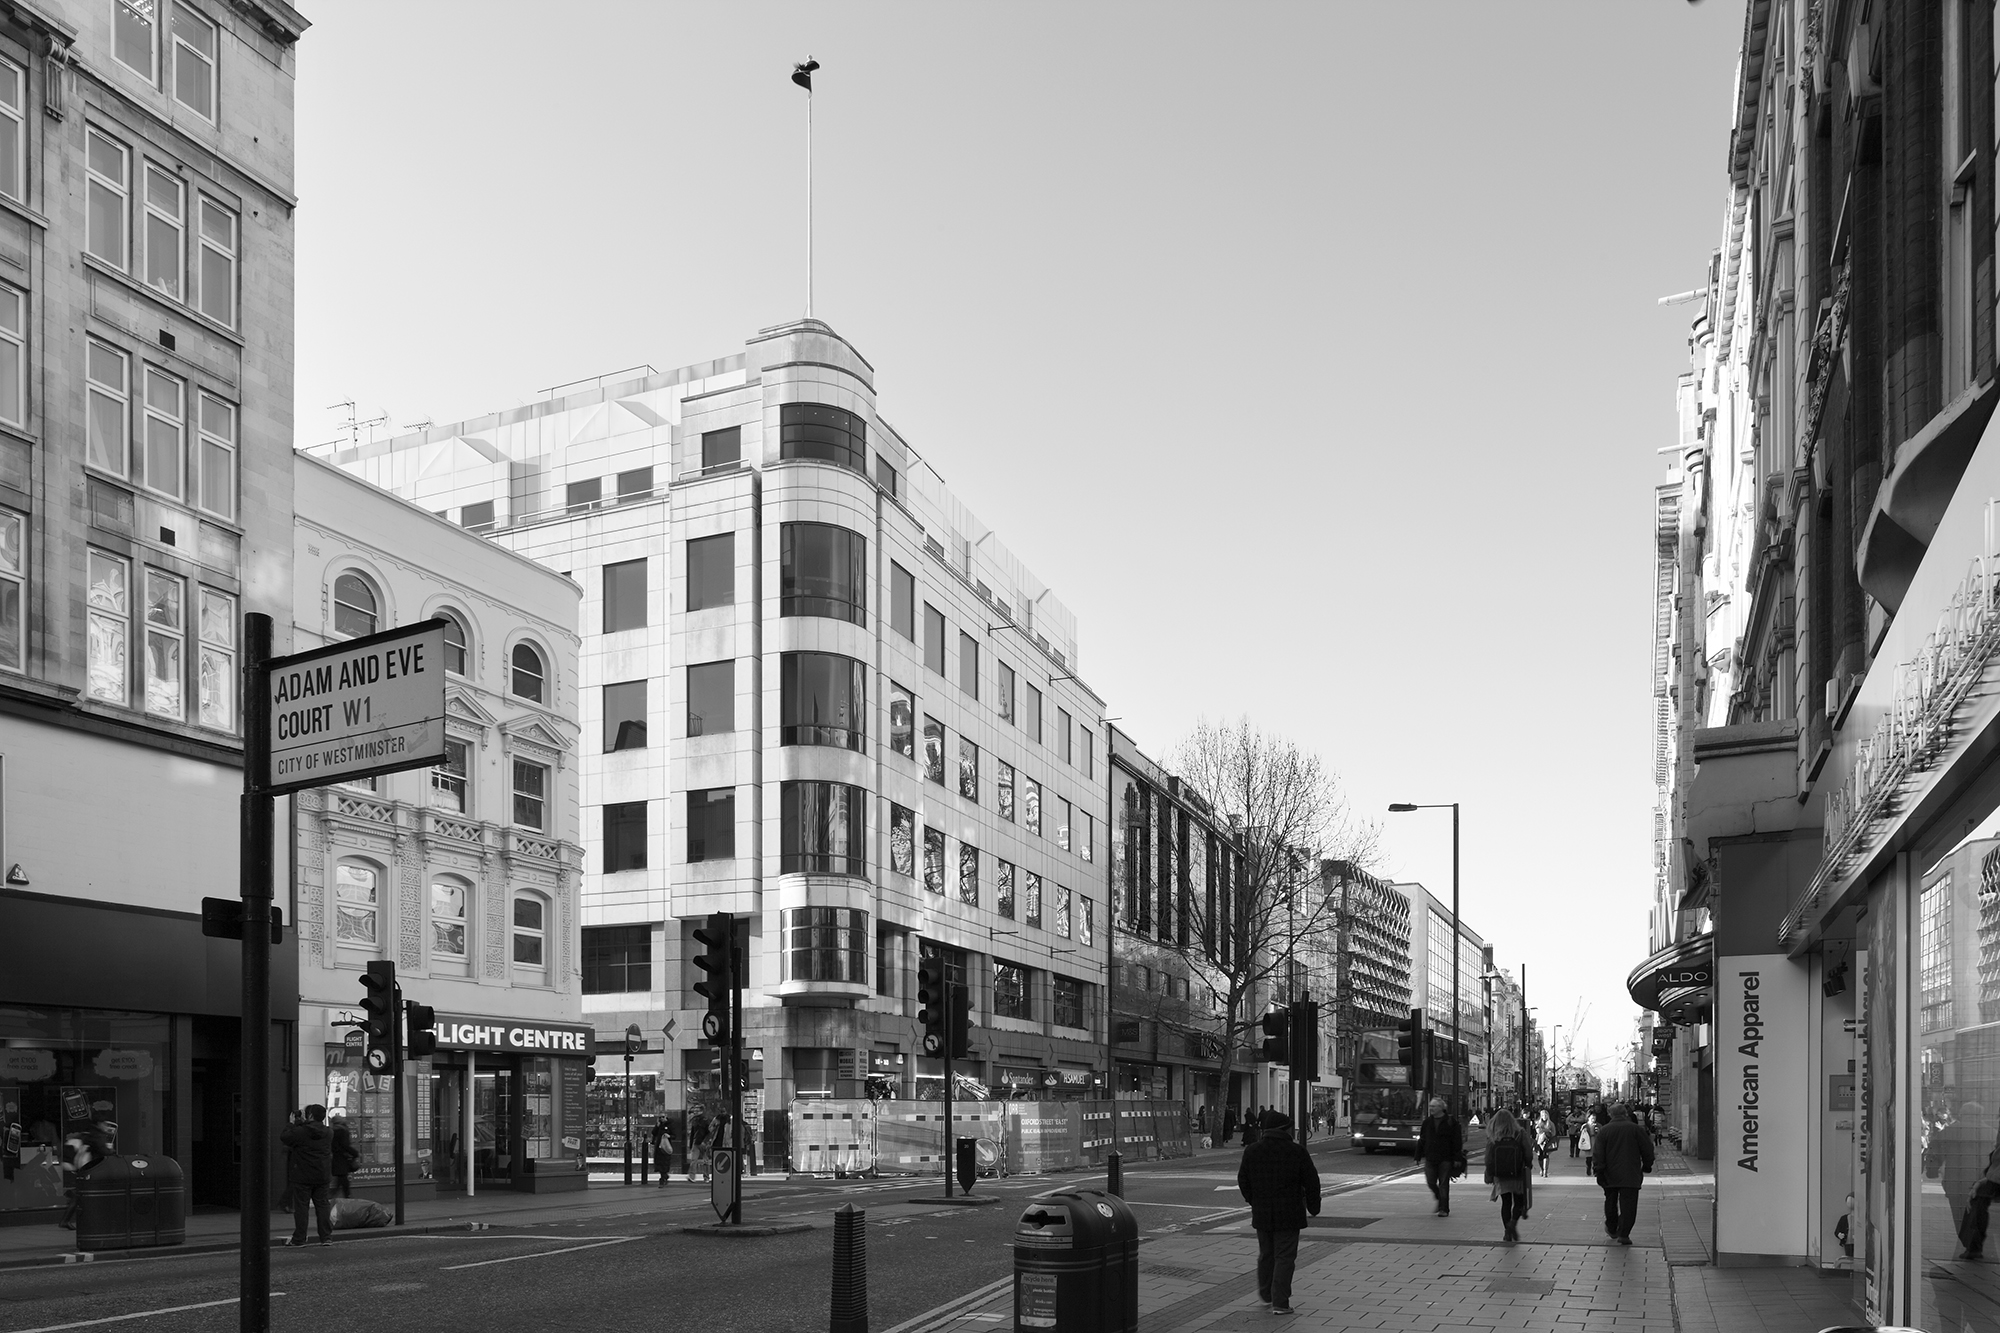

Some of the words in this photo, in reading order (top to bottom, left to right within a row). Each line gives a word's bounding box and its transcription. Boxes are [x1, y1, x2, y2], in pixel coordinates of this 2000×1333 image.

[278, 665, 332, 703] ADAM
[339, 654, 379, 690] AND
[386, 643, 425, 680] EVE
[278, 704, 333, 741] COURT
[343, 696, 371, 727] W1
[278, 756, 302, 775] CITY
[306, 753, 319, 770] OF
[323, 736, 405, 767] WESTMINSTER
[1657, 972, 1709, 983] ALDO
[1737, 971, 1763, 1059] Apparel
[509, 1028, 586, 1050] CENTRE
[1122, 1028, 1138, 1036] M&S
[1009, 1071, 1034, 1085] Santander
[1020, 1118, 1039, 1126] OXFORD
[1039, 1118, 1054, 1126] STREET
[1737, 1064, 1759, 1173] American
